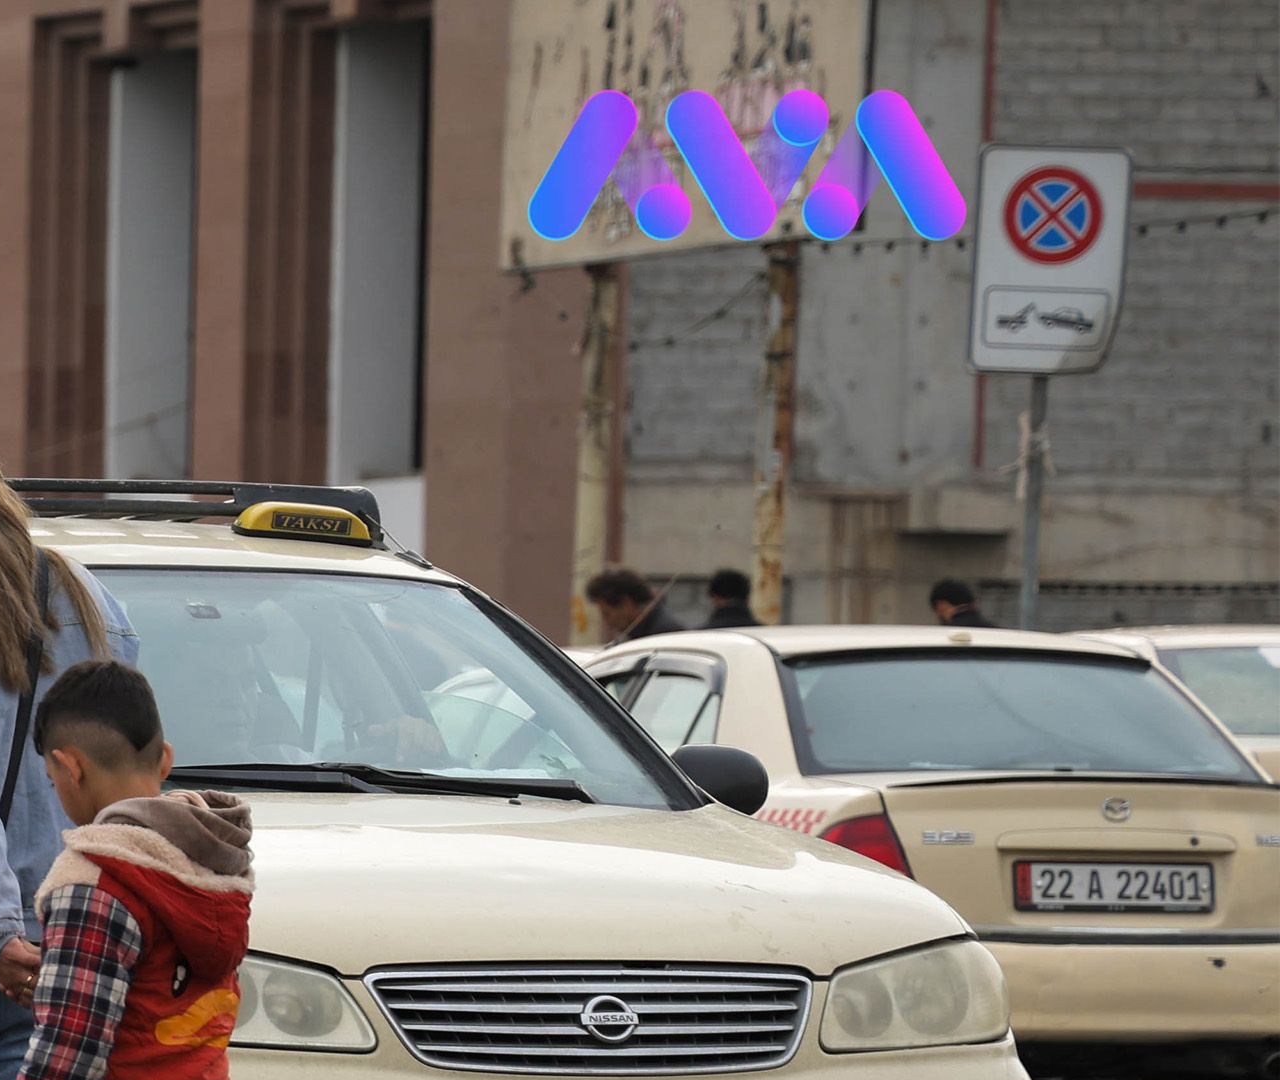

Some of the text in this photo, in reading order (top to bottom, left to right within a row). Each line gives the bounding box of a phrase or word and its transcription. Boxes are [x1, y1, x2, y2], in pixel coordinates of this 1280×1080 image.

[281, 515, 342, 532] TAKSI
[1040, 869, 1074, 899] 22
[1088, 870, 1104, 900] A
[1116, 870, 1202, 901] 22401
[588, 1013, 634, 1024] NISSAN
